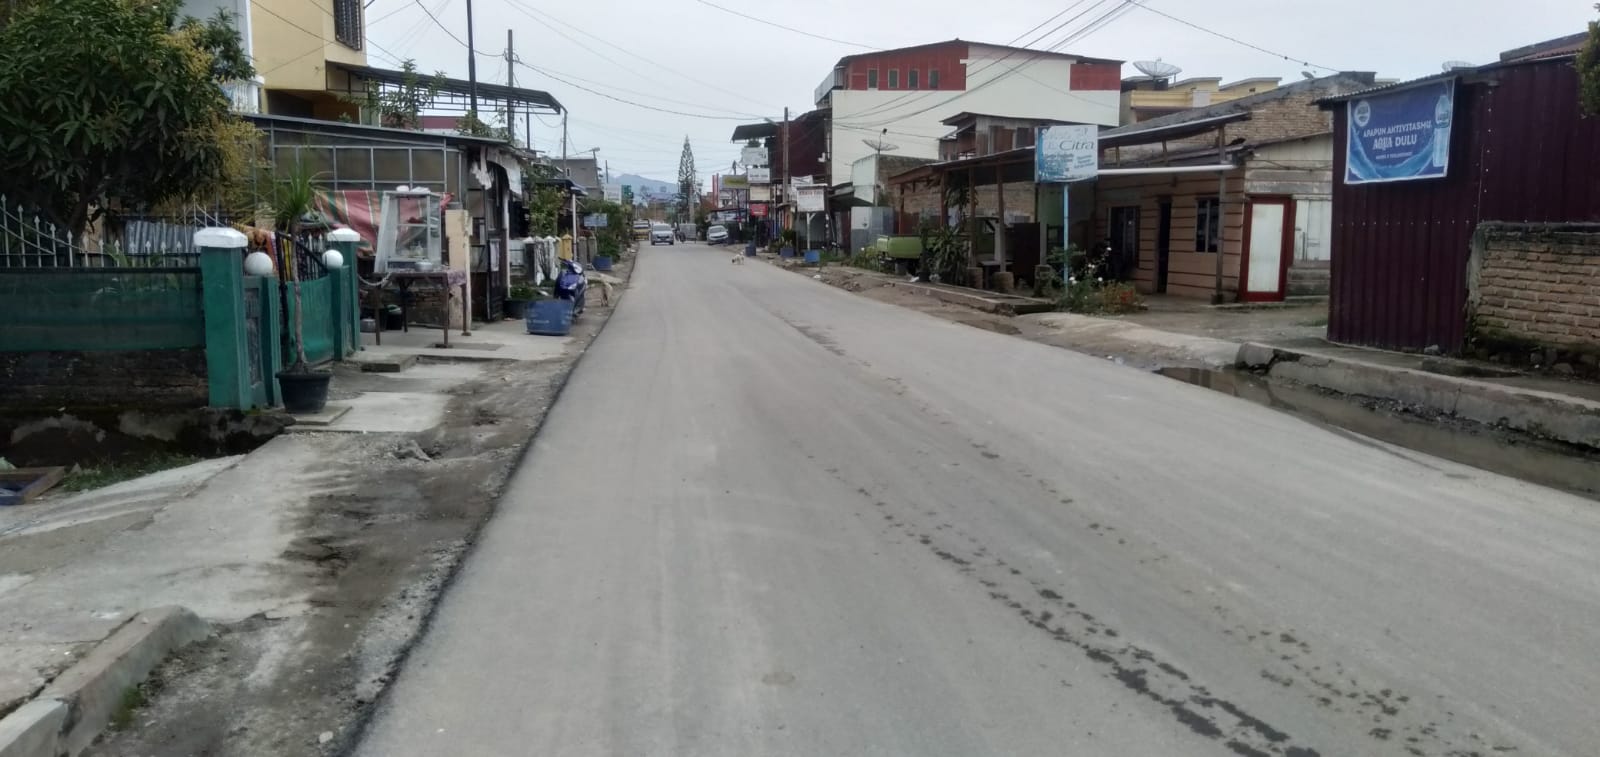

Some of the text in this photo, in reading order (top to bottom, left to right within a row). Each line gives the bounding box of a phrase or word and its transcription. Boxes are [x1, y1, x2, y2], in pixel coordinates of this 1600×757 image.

[1059, 139, 1094, 151] Citra
[1373, 134, 1417, 150] AQUA DULU
